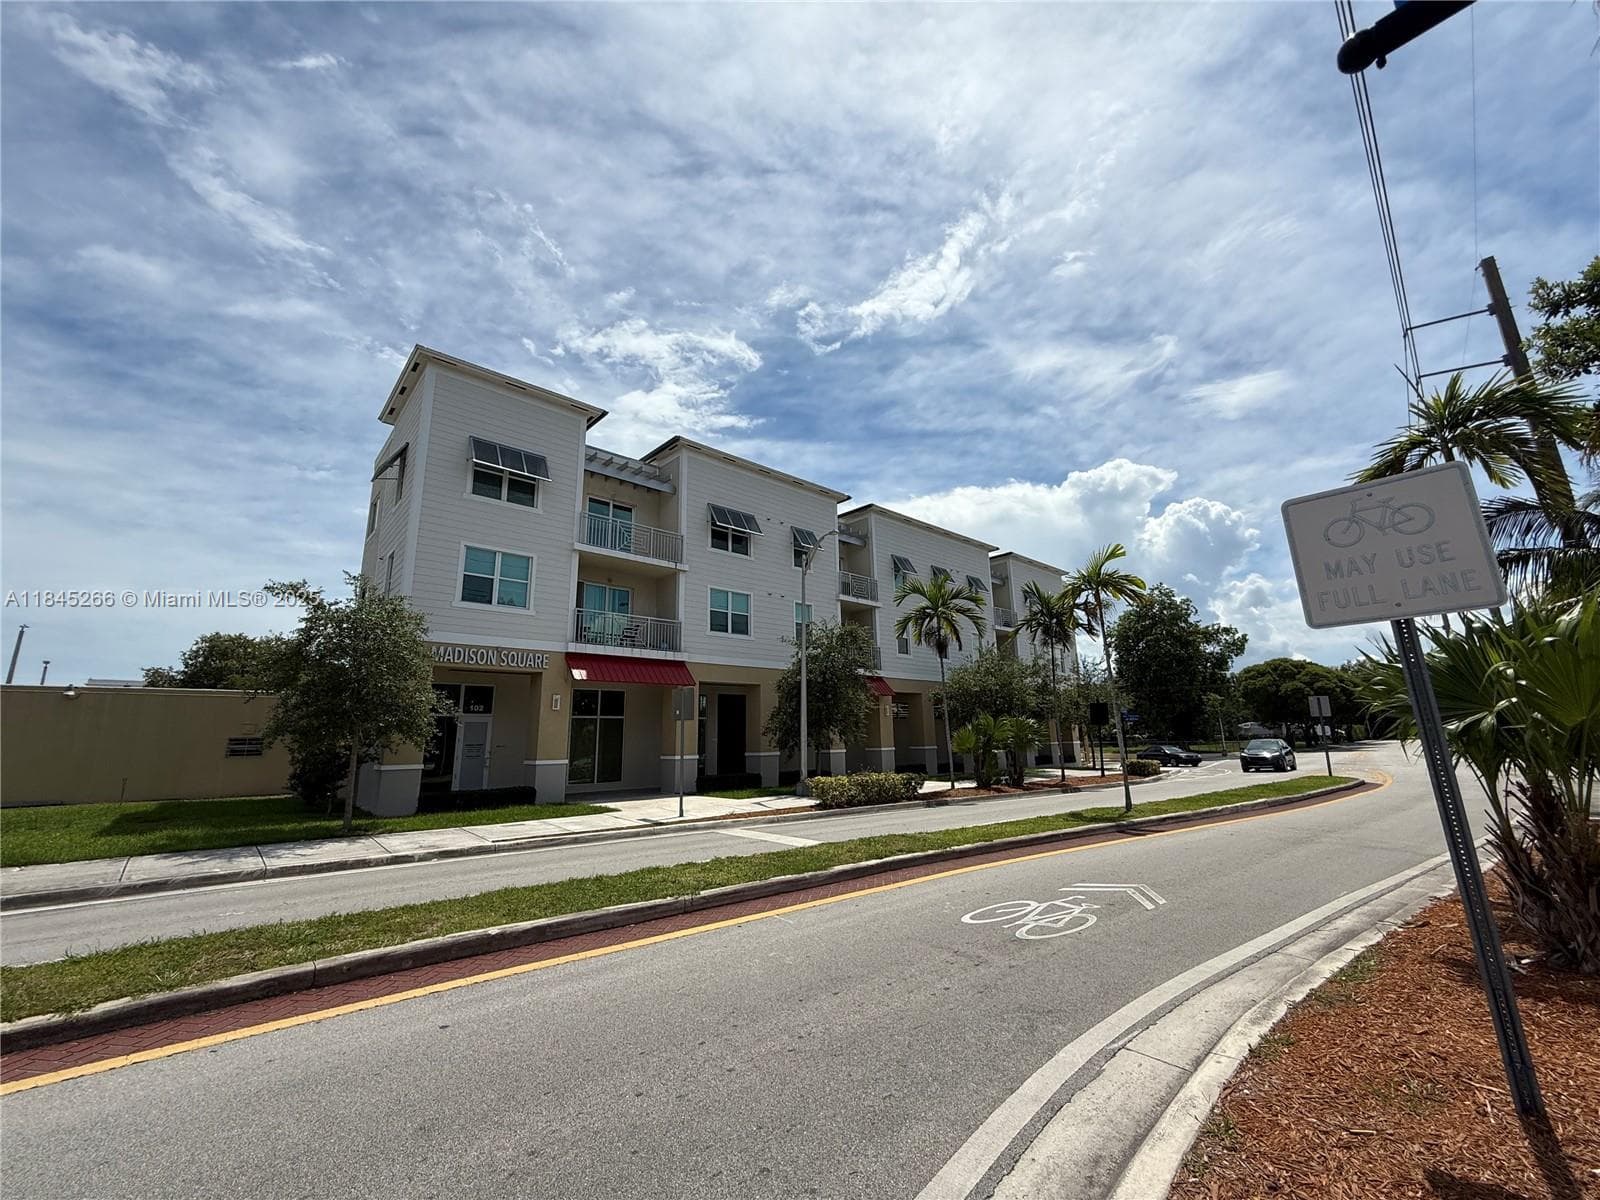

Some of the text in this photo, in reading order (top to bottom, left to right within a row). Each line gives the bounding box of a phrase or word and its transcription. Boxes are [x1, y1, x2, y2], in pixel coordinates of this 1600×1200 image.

[1323, 540, 1456, 580] MAY USE
[1317, 568, 1481, 611] FULL LANE
[431, 646, 550, 669] MADISON SQUARE
